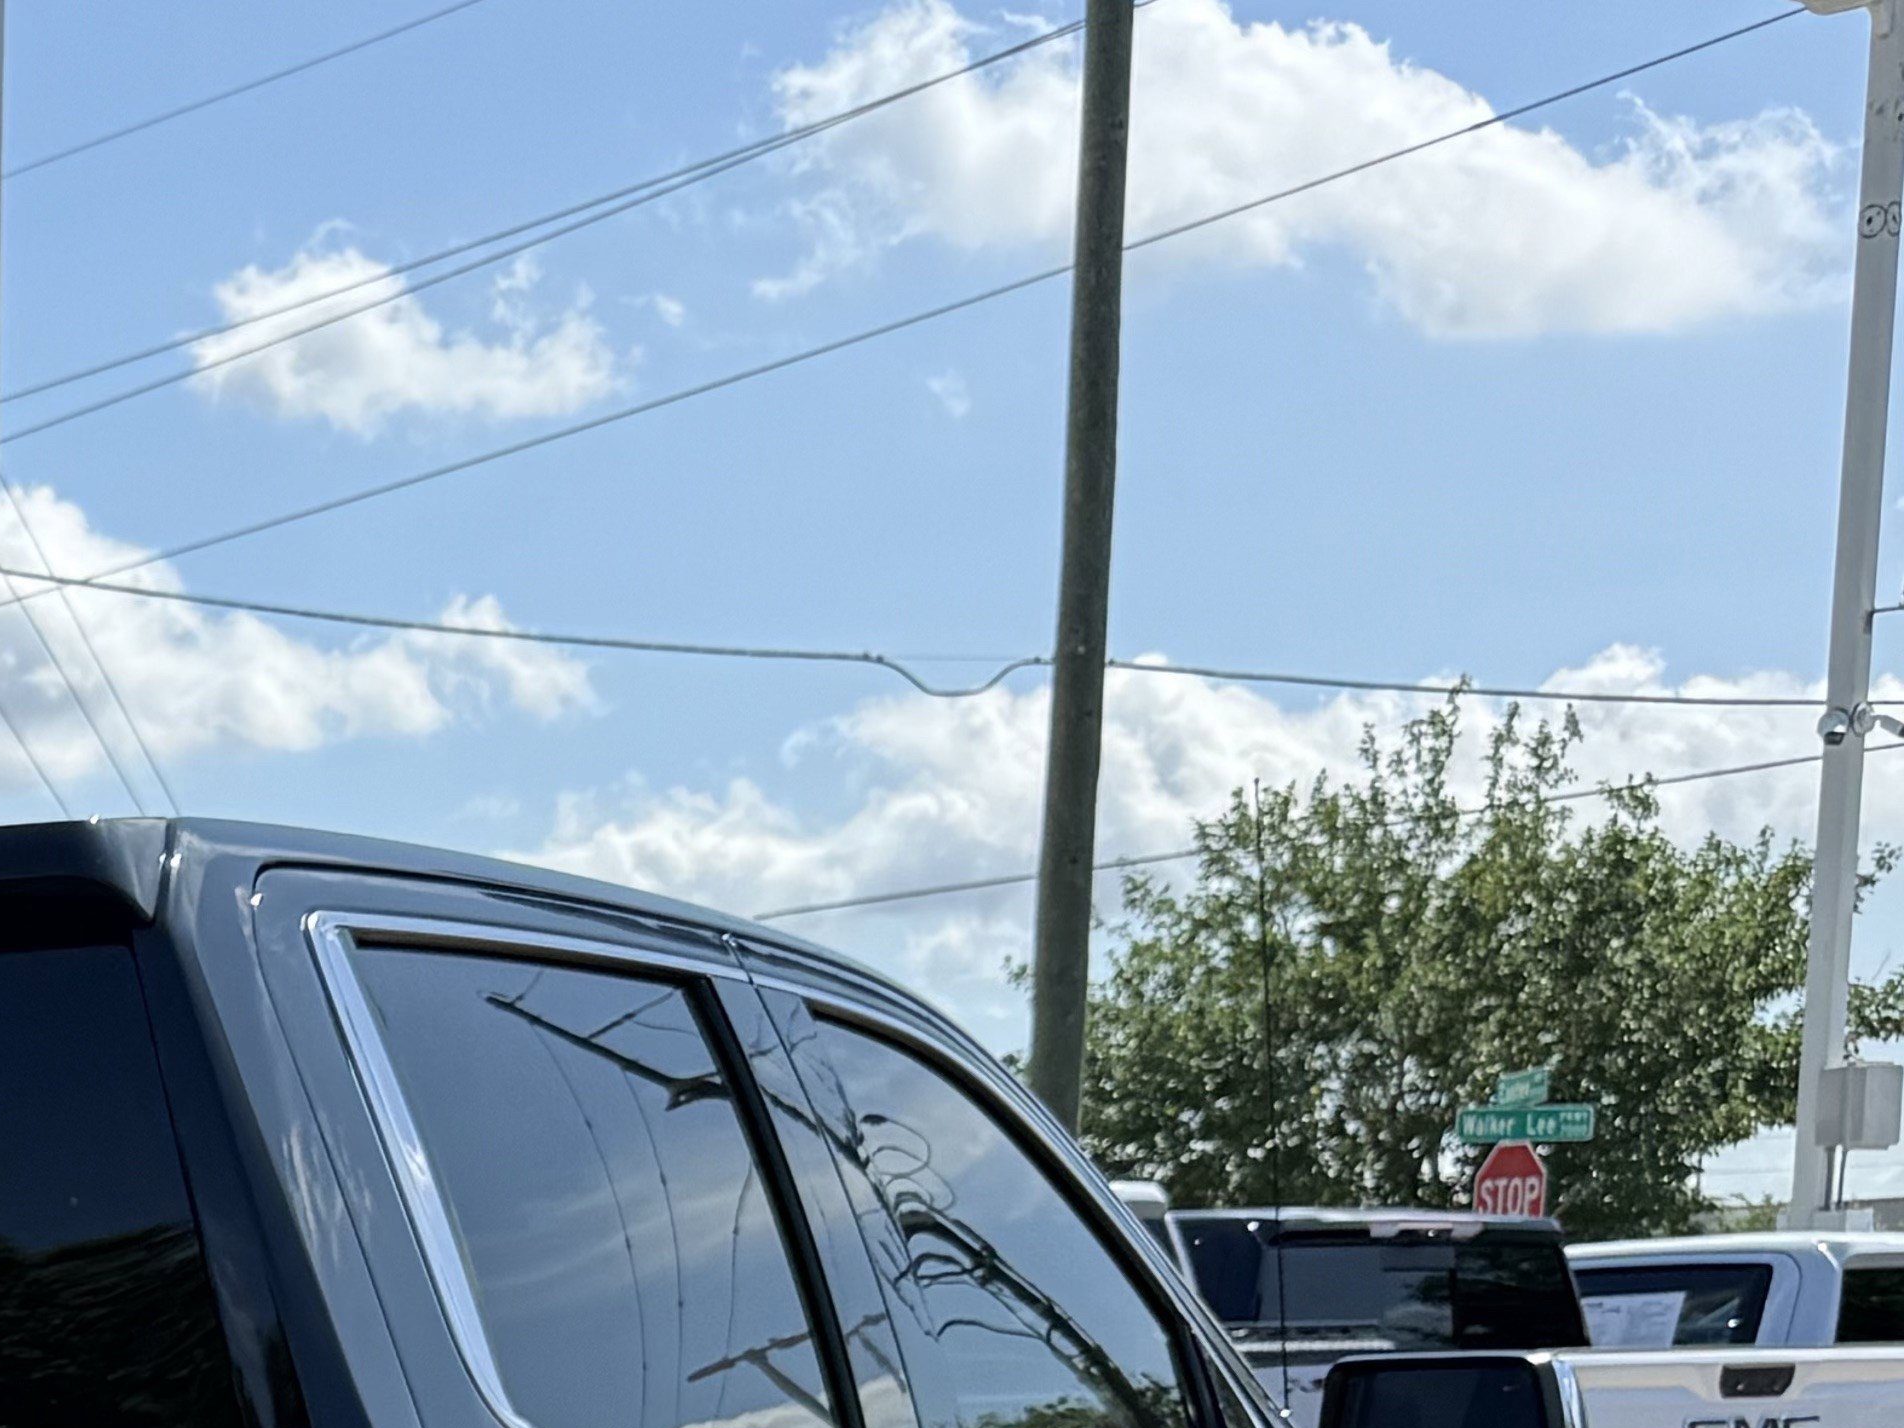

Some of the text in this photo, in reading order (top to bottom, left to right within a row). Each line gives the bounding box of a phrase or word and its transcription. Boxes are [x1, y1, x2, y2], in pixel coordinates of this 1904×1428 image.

[1462, 1114, 1517, 1137] Walker
[1526, 1113, 1557, 1136] Lee
[1478, 1173, 1540, 1217] STOP
